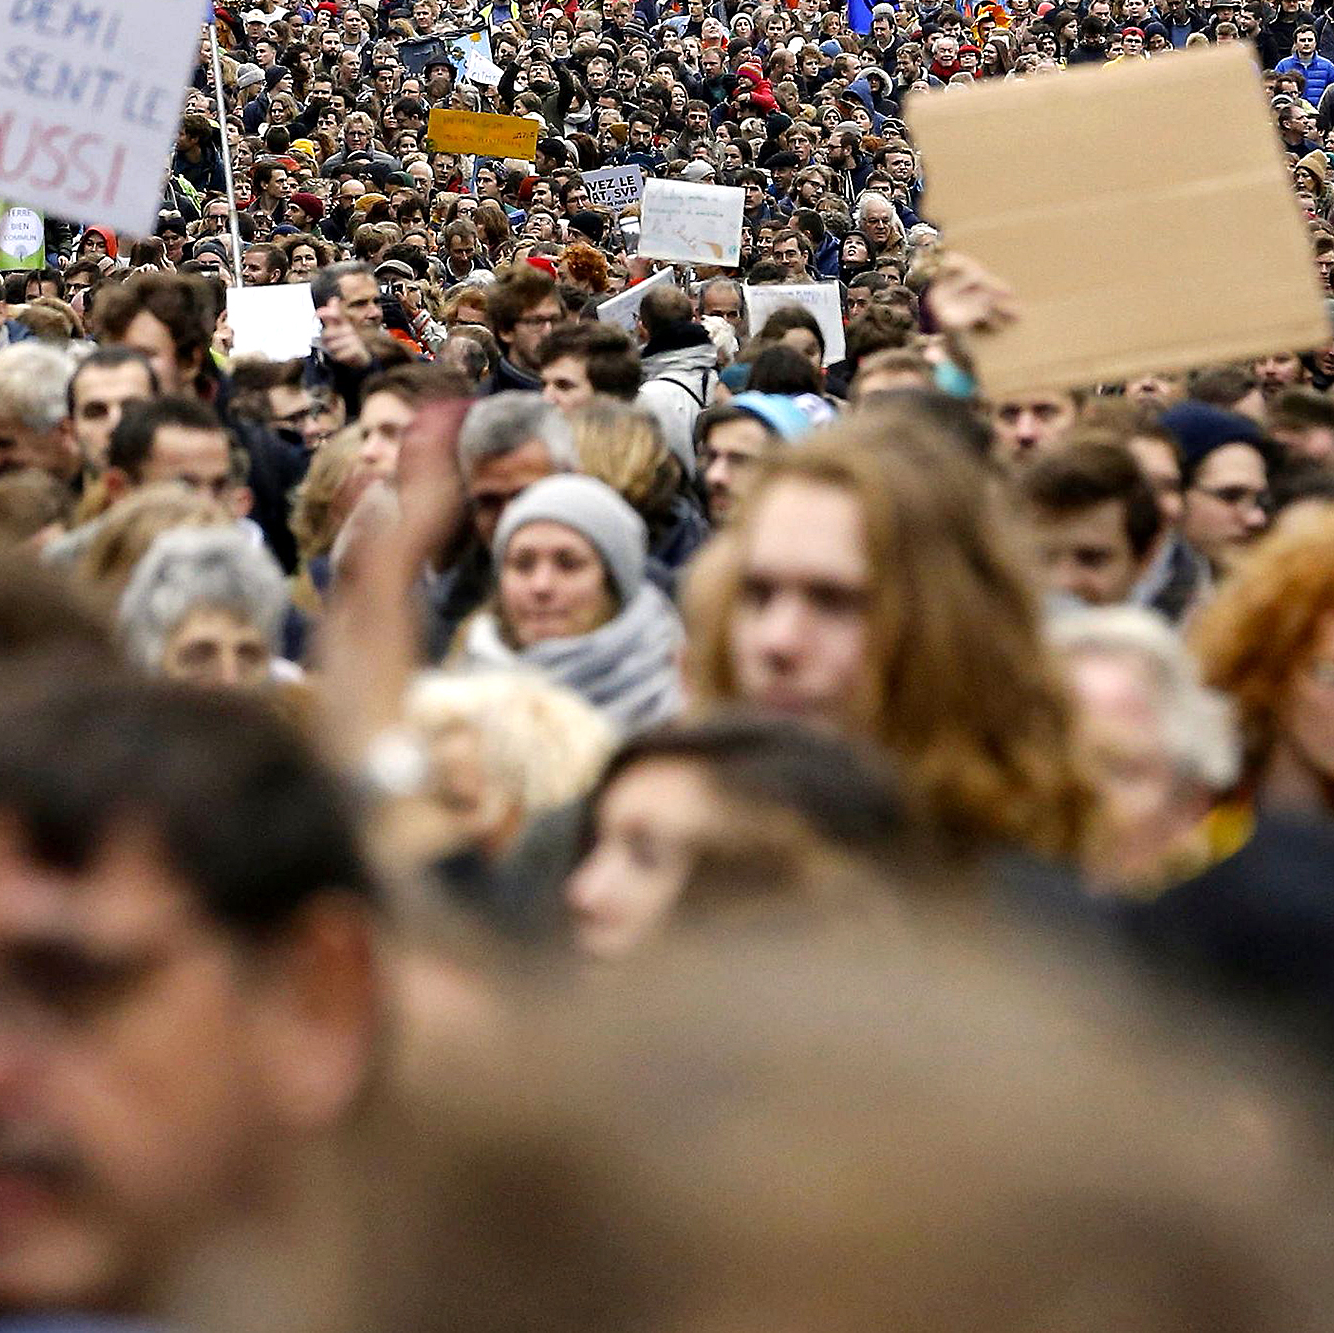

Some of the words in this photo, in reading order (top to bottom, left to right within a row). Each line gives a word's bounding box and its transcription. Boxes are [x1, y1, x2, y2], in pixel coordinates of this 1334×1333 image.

[587, 177, 616, 191] VEZ
[619, 175, 635, 187] LE
[614, 186, 638, 198] SVP
